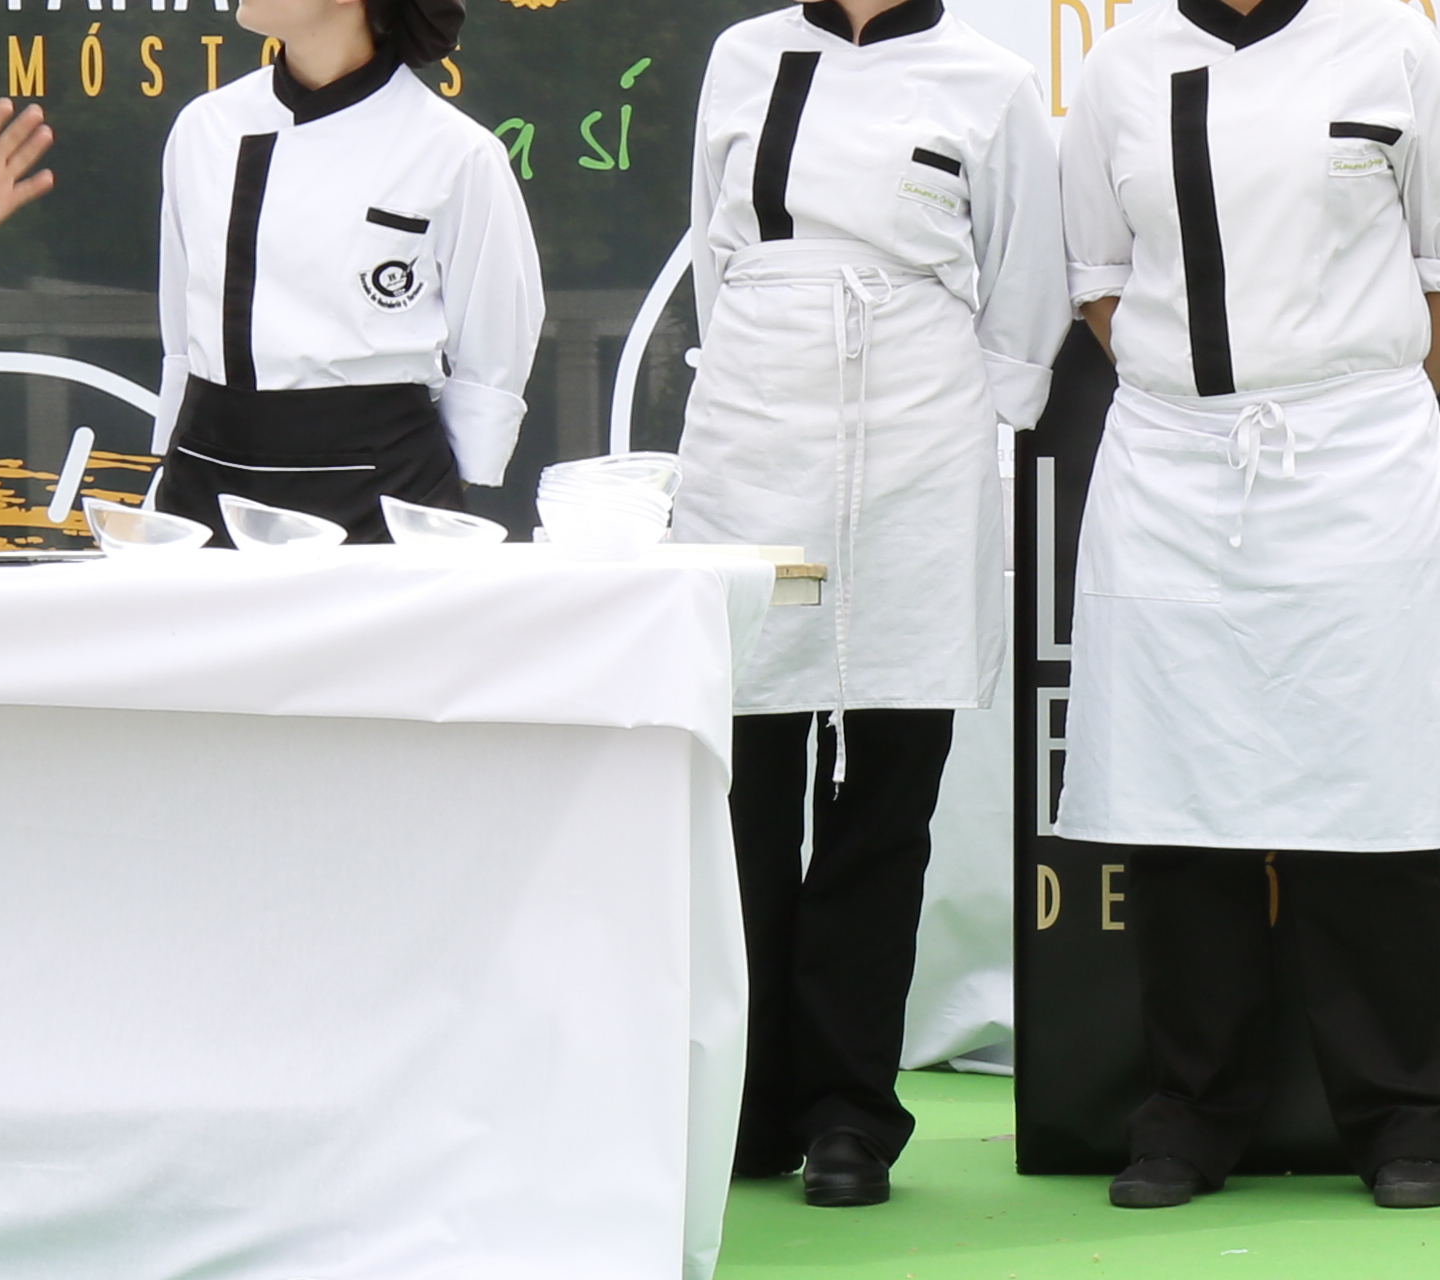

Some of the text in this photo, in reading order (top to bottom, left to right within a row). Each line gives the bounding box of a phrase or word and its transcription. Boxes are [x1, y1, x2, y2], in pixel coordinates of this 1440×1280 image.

[7, 22, 463, 98] MÓSTS
[577, 56, 653, 171] sí
[1036, 863, 1127, 931] DE
